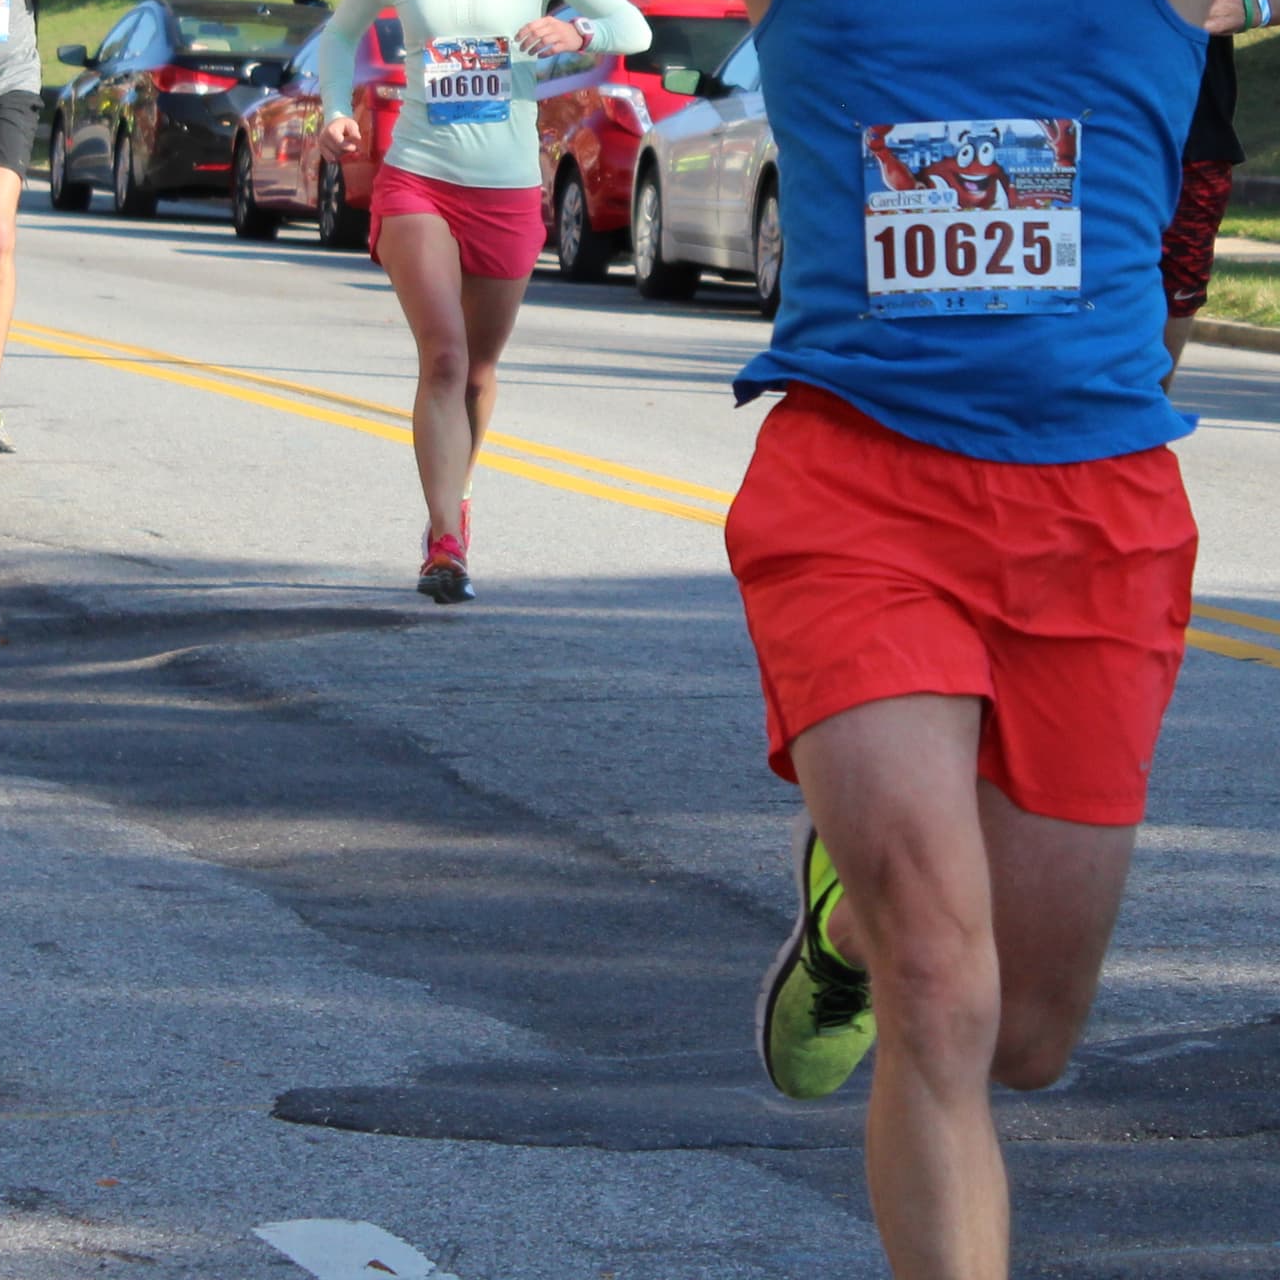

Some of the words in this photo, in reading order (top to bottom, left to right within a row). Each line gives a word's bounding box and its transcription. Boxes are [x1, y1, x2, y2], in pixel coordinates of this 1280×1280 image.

[428, 74, 500, 98] 10600
[870, 190, 924, 209] CareFirst
[874, 220, 1052, 280] 10625
